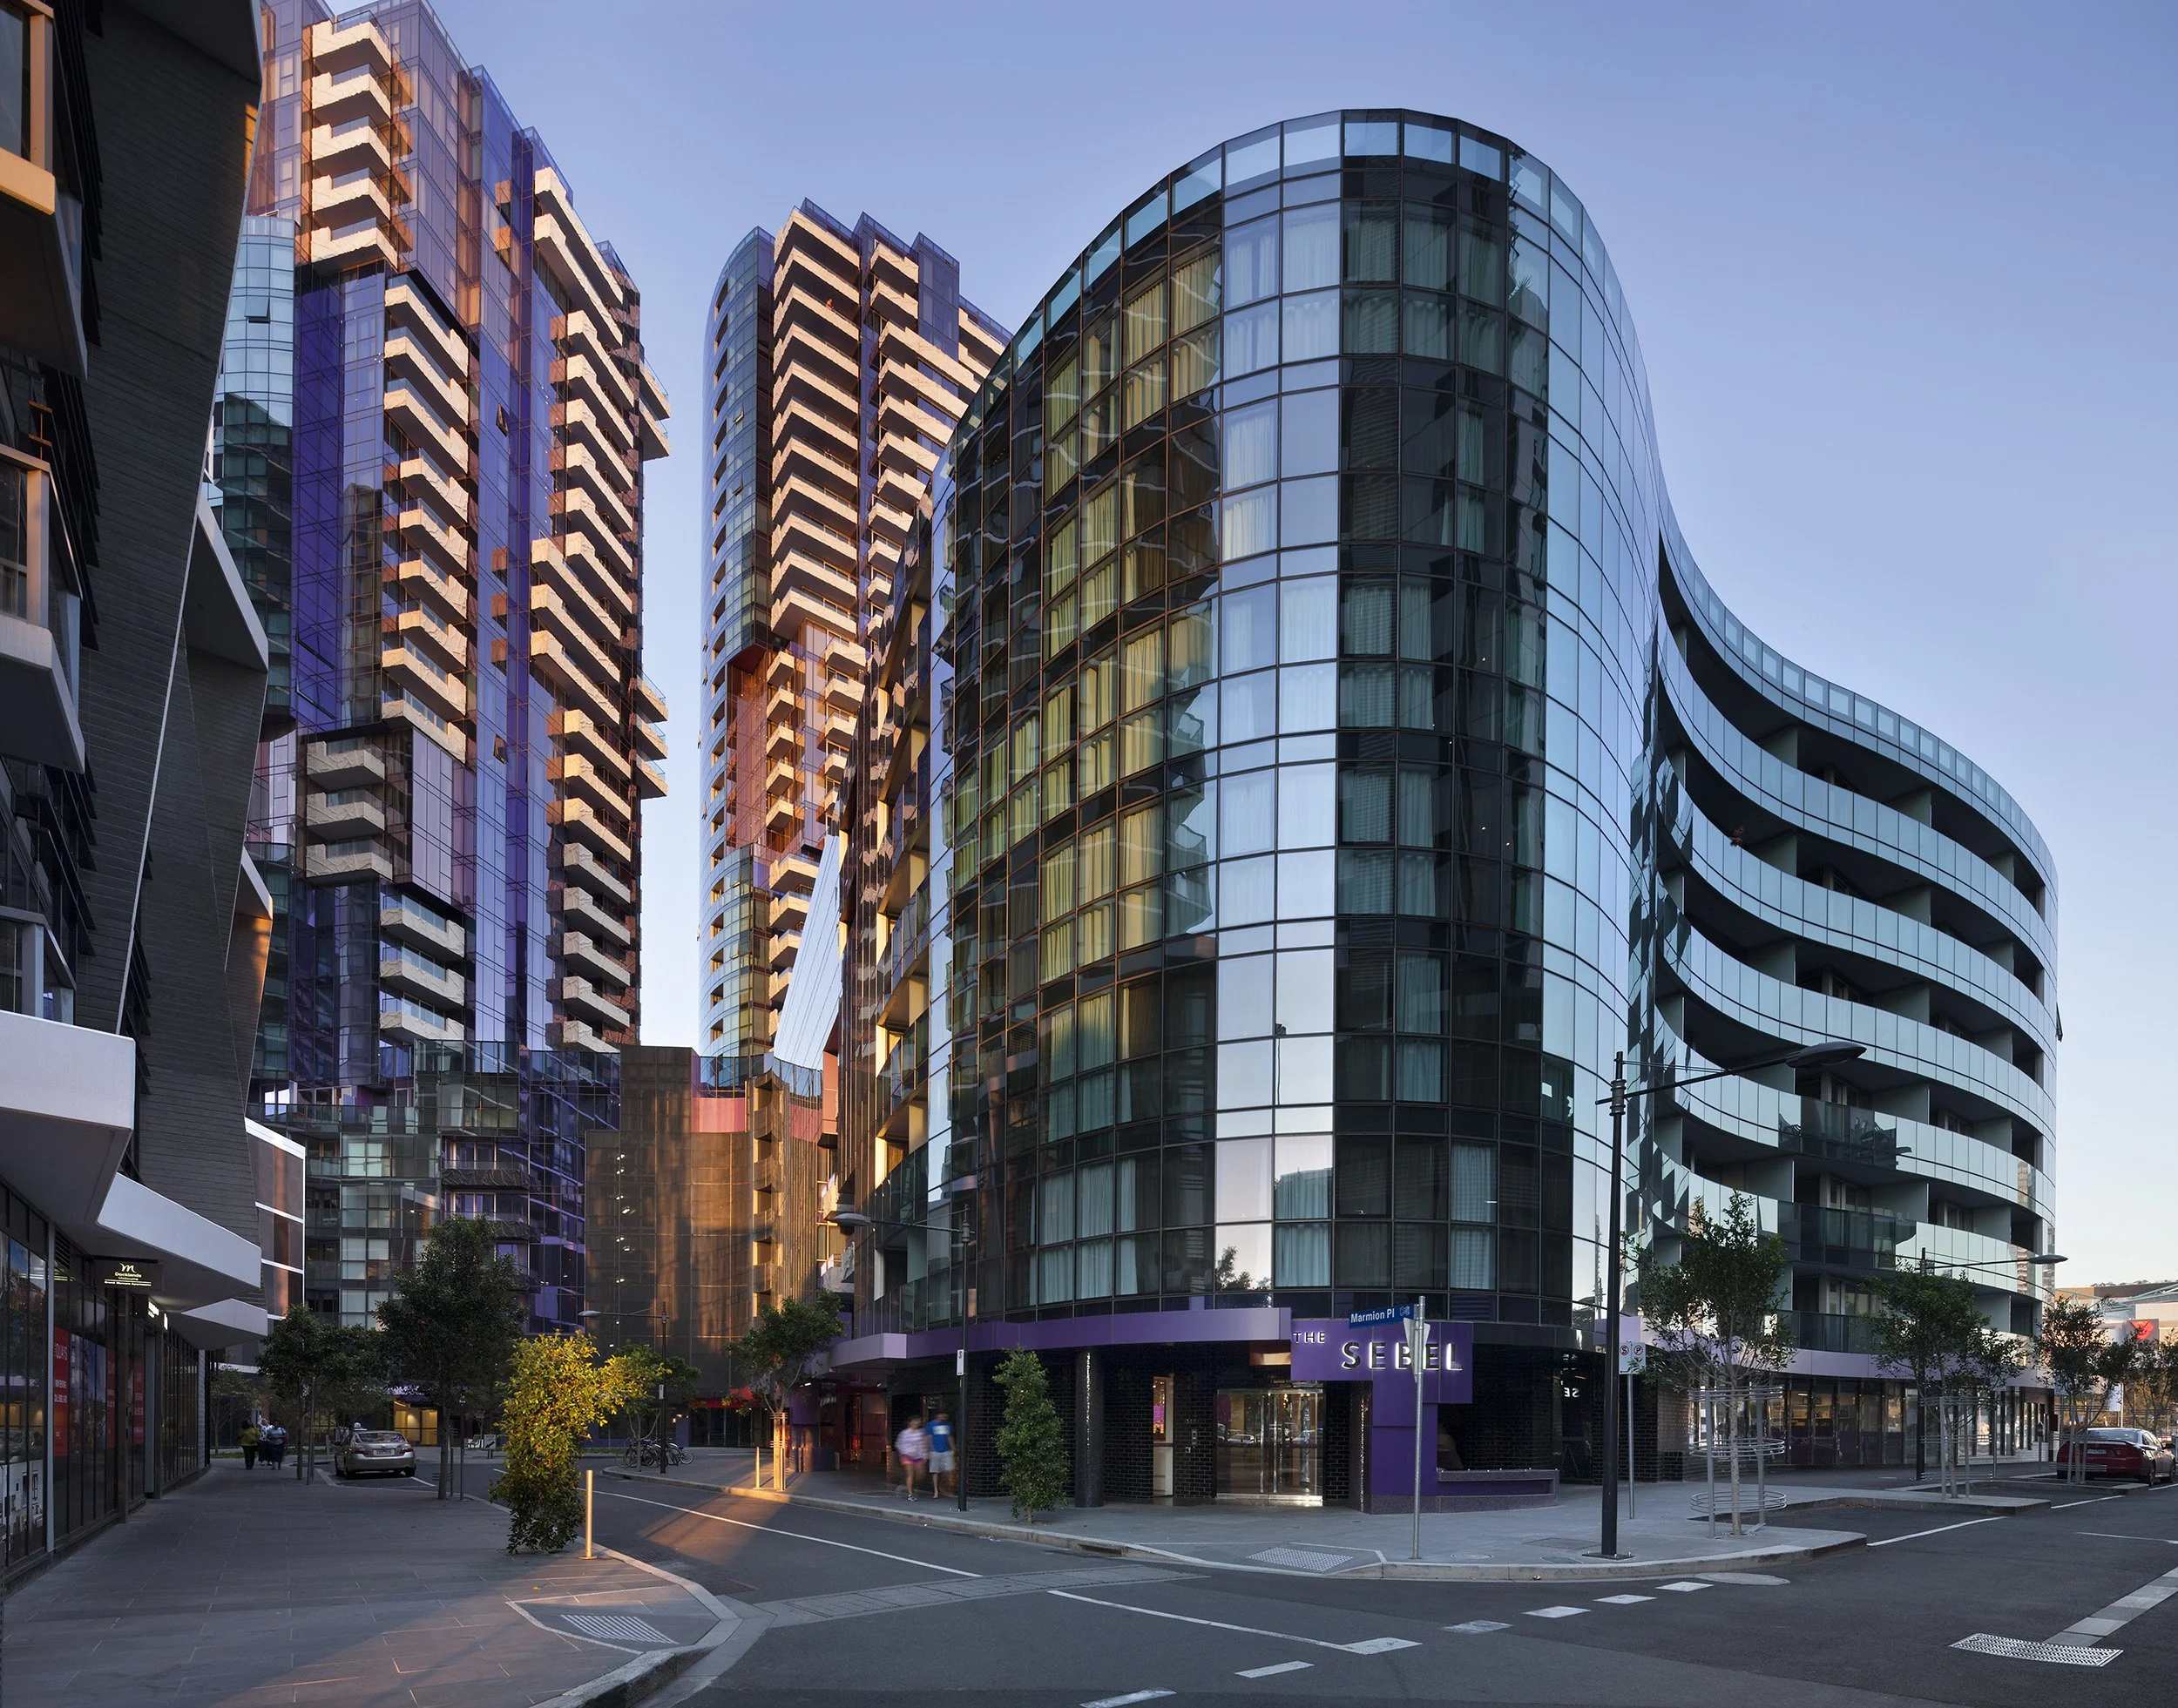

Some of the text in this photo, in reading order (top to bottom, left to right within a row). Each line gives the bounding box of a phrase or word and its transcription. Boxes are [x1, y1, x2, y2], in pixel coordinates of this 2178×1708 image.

[1350, 1308, 1395, 1323] Marmion Pl
[1293, 1332, 1325, 1344] THE
[1342, 1341, 1463, 1370] SEBEL
